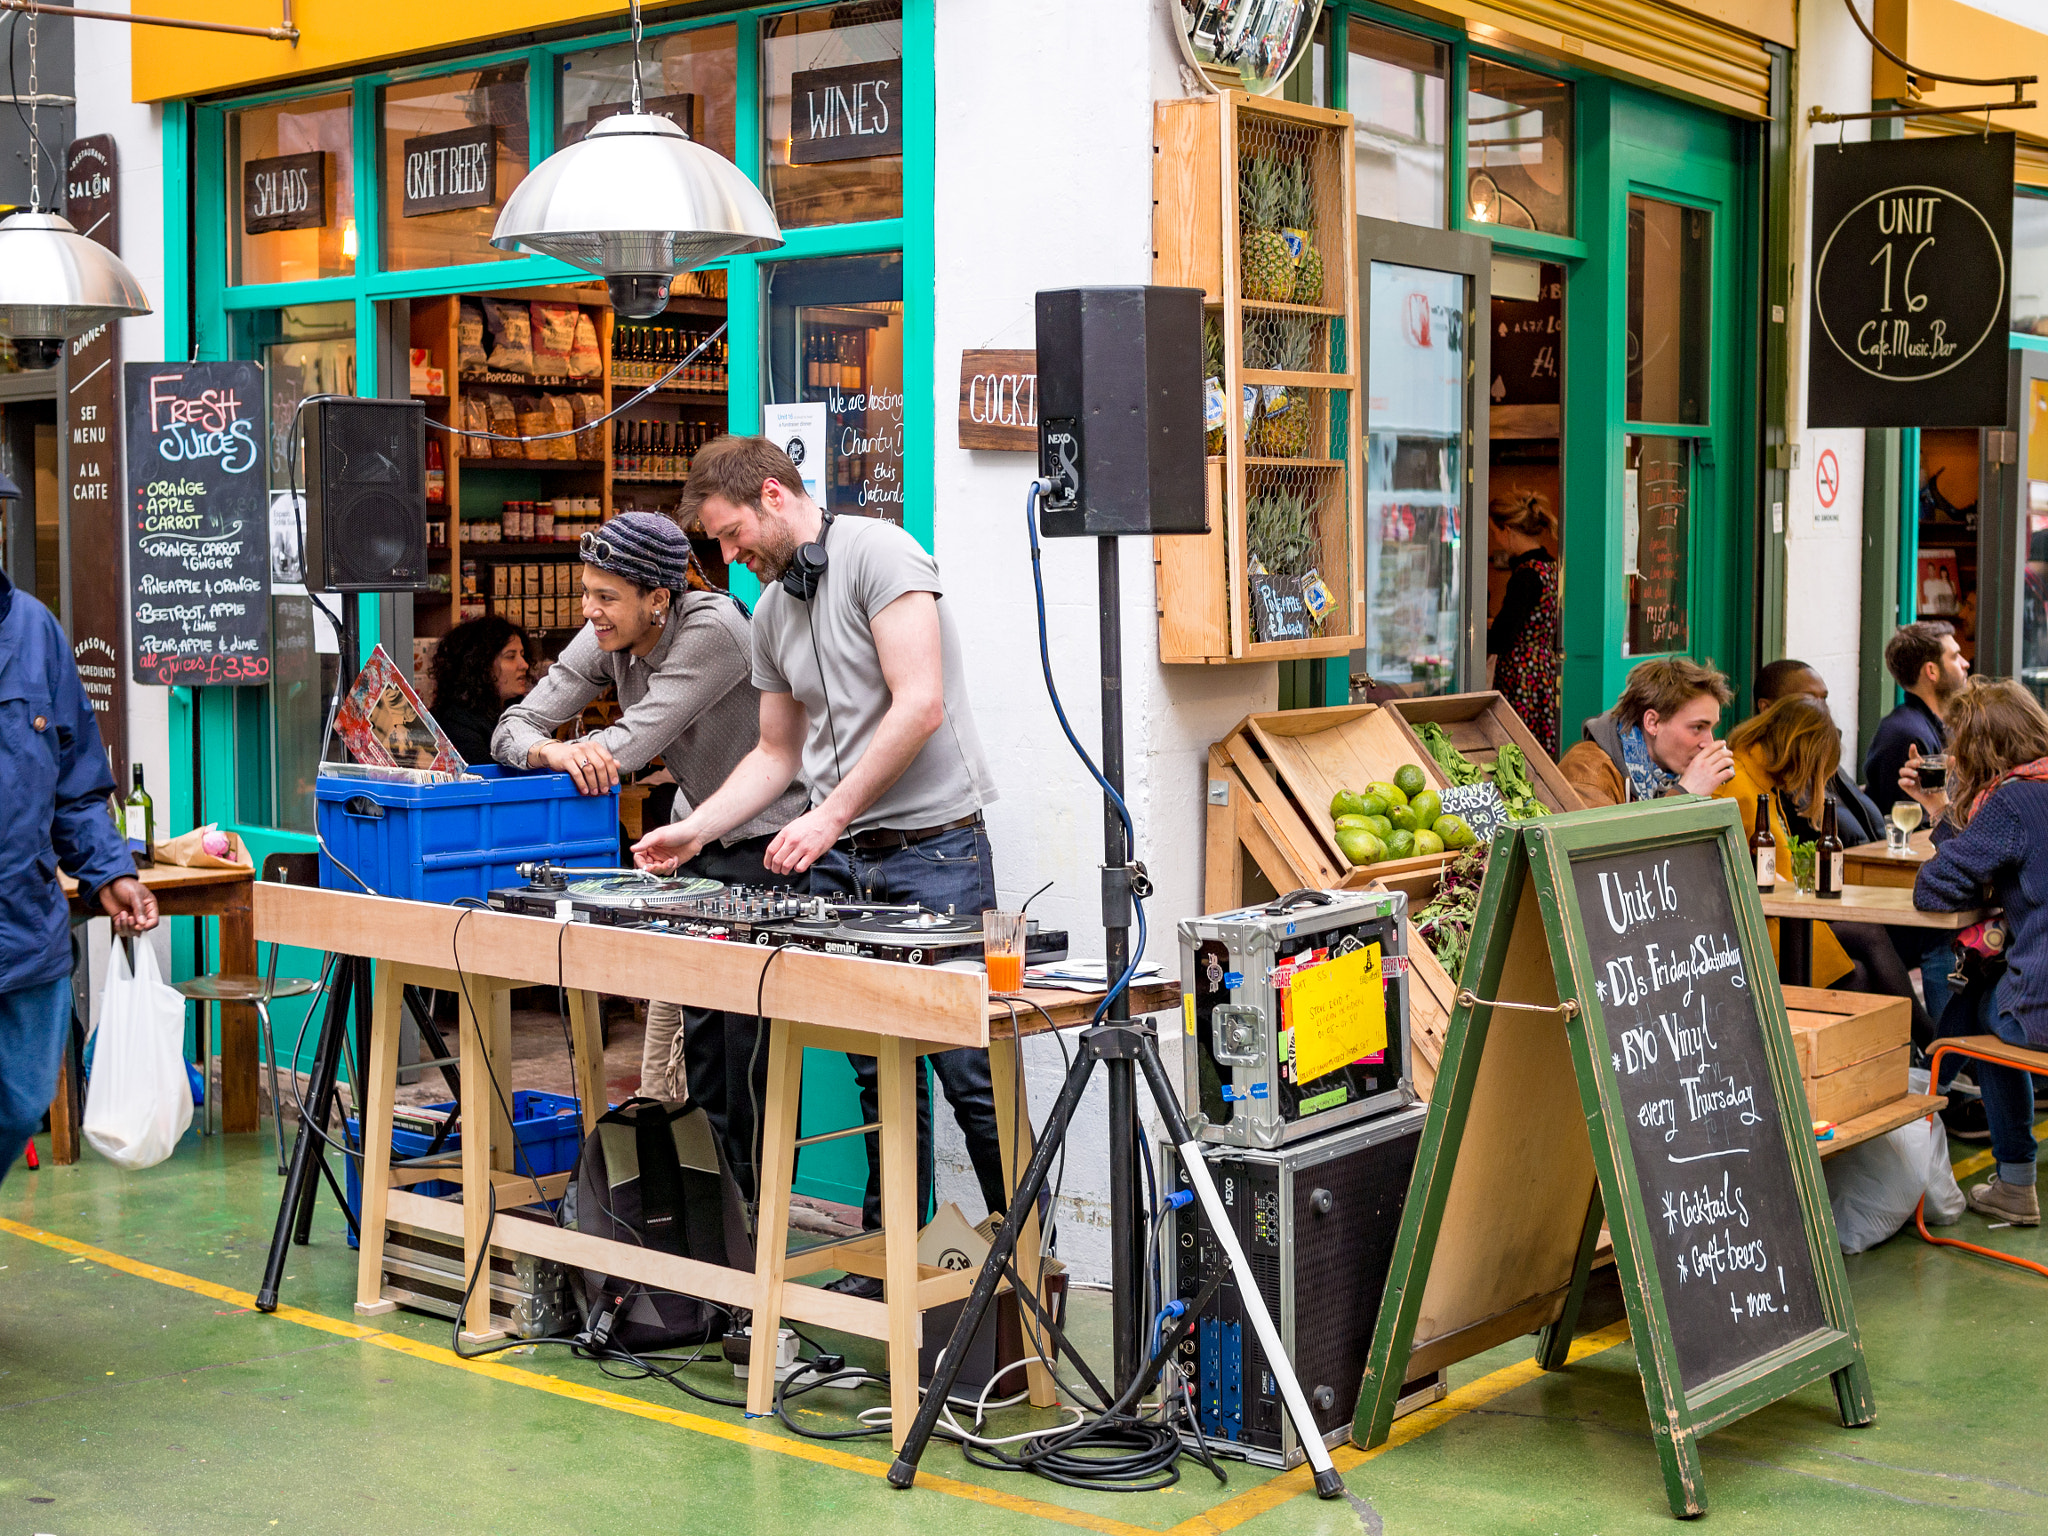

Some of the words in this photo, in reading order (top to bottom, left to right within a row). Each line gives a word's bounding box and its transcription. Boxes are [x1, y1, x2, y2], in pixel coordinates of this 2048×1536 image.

[807, 79, 890, 140] WINES
[406, 148, 448, 200] CRAFT
[449, 142, 488, 195] BEERS
[253, 167, 308, 217] SALADS
[1878, 197, 1942, 235] UNIT
[1869, 236, 1936, 314] 16
[485, 372, 525, 384] POPCORN
[150, 374, 242, 433] FRESH
[828, 382, 848, 414] We
[847, 393, 868, 412] are
[867, 385, 904, 422] hosting
[969, 373, 1037, 427] COCKT
[80, 405, 98, 421] SET
[73, 426, 106, 444] MENU
[159, 419, 257, 474] JUICES
[841, 425, 894, 464] Charity
[1047, 433, 1072, 445] NEXO
[79, 462, 87, 477] A
[88, 462, 100, 477] LA
[873, 462, 896, 482] this
[73, 483, 108, 501] CARTE
[146, 478, 207, 497] ORANGE
[145, 497, 195, 515] APPLE
[145, 514, 204, 532] CARROT
[202, 541, 244, 557] CARROT
[189, 556, 233, 572] GINGER
[141, 573, 202, 596] PINEAPPLE
[213, 575, 262, 595] ORANGE
[208, 602, 246, 619] APPLE
[74, 636, 116, 661] SEASONAL
[178, 635, 213, 654] APPLE
[76, 664, 116, 679] NGREDIENTS
[139, 652, 158, 668] all
[82, 681, 112, 696] NVENTIVE
[91, 698, 110, 712] SHES
[1442, 791, 1492, 814] OCADO
[1597, 870, 1656, 935] Unit
[1652, 859, 1678, 912] 16
[824, 940, 860, 955] gemini
[1605, 955, 1649, 1007] DJs
[1645, 942, 1694, 1008] Friday
[1694, 932, 1747, 989] Saturday
[1621, 1025, 1658, 1075] BYO
[1658, 994, 1718, 1075] Vinyl
[1636, 1097, 1679, 1143] every
[1679, 1075, 1764, 1125] Thursday
[1225, 1177, 1235, 1206] NEXO
[1679, 1169, 1750, 1228] Cocktails
[1691, 1233, 1725, 1285] Craft
[1724, 1227, 1768, 1273] beers
[1261, 1370, 1269, 1395] QSC
